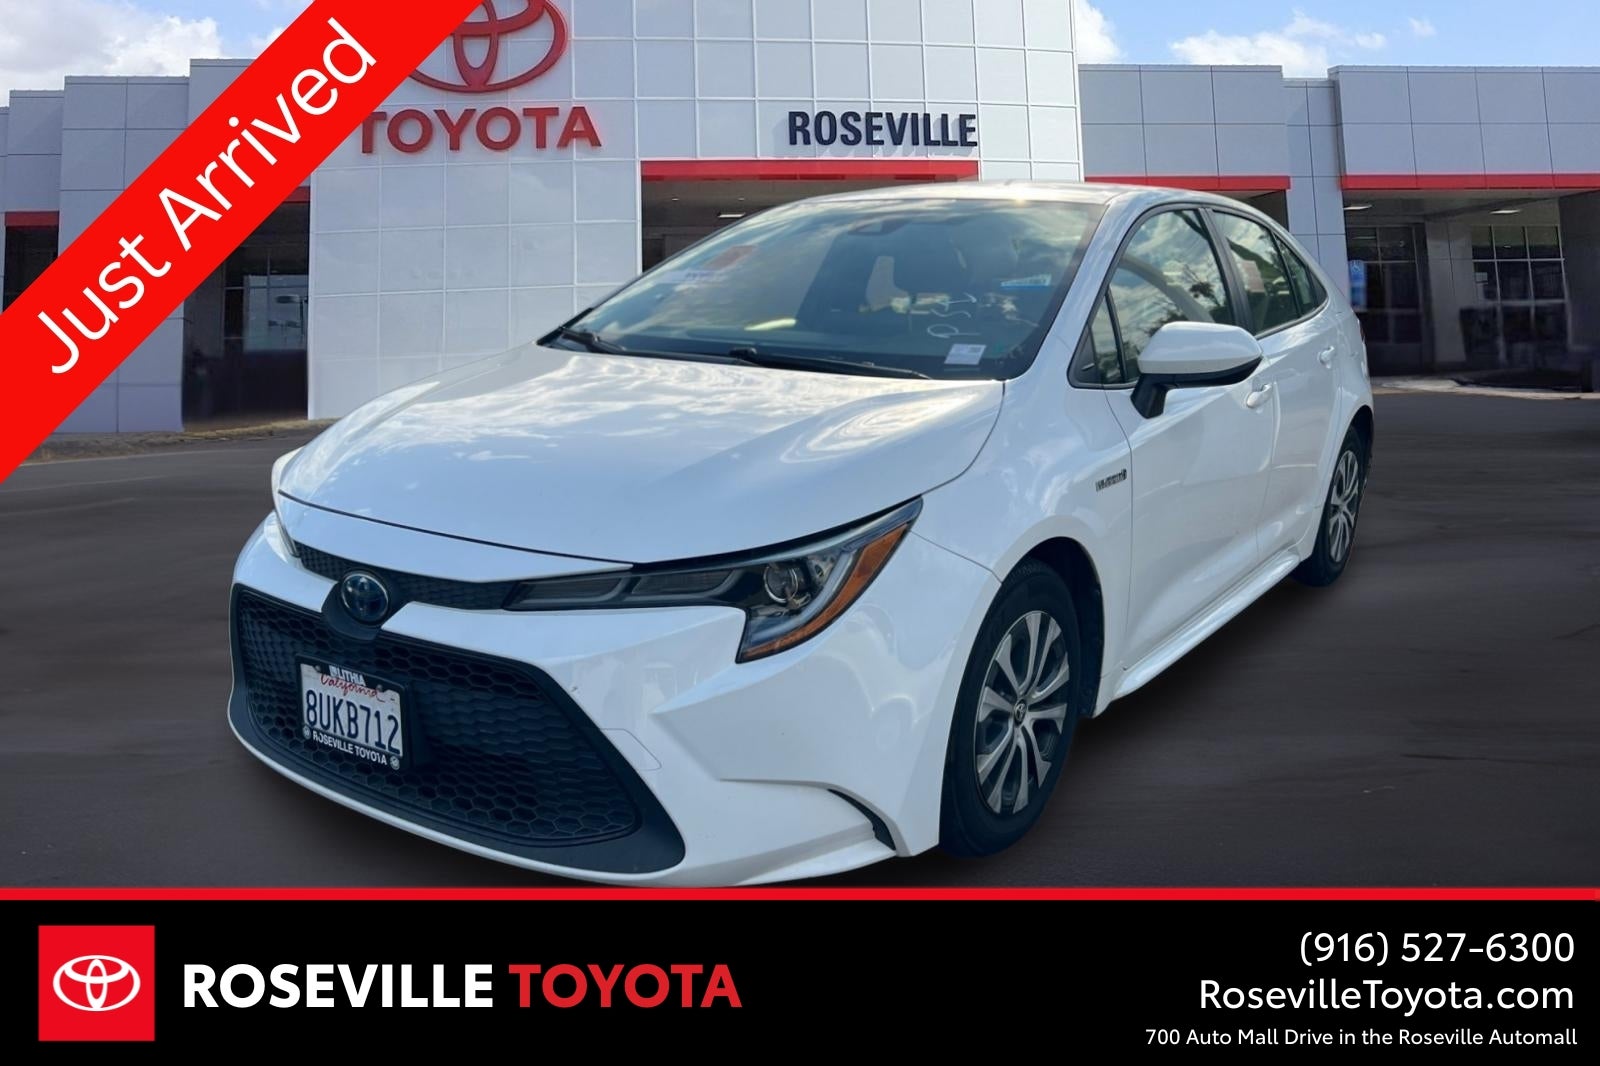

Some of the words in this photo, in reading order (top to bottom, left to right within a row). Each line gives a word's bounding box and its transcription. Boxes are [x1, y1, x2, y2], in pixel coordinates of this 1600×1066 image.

[361, 106, 602, 154] TOYOTA
[788, 110, 978, 147] ROSEVILLE
[305, 689, 401, 755] 8UKB712
[312, 730, 354, 755] ROSEVILLE
[354, 745, 388, 766] TOYOTA
